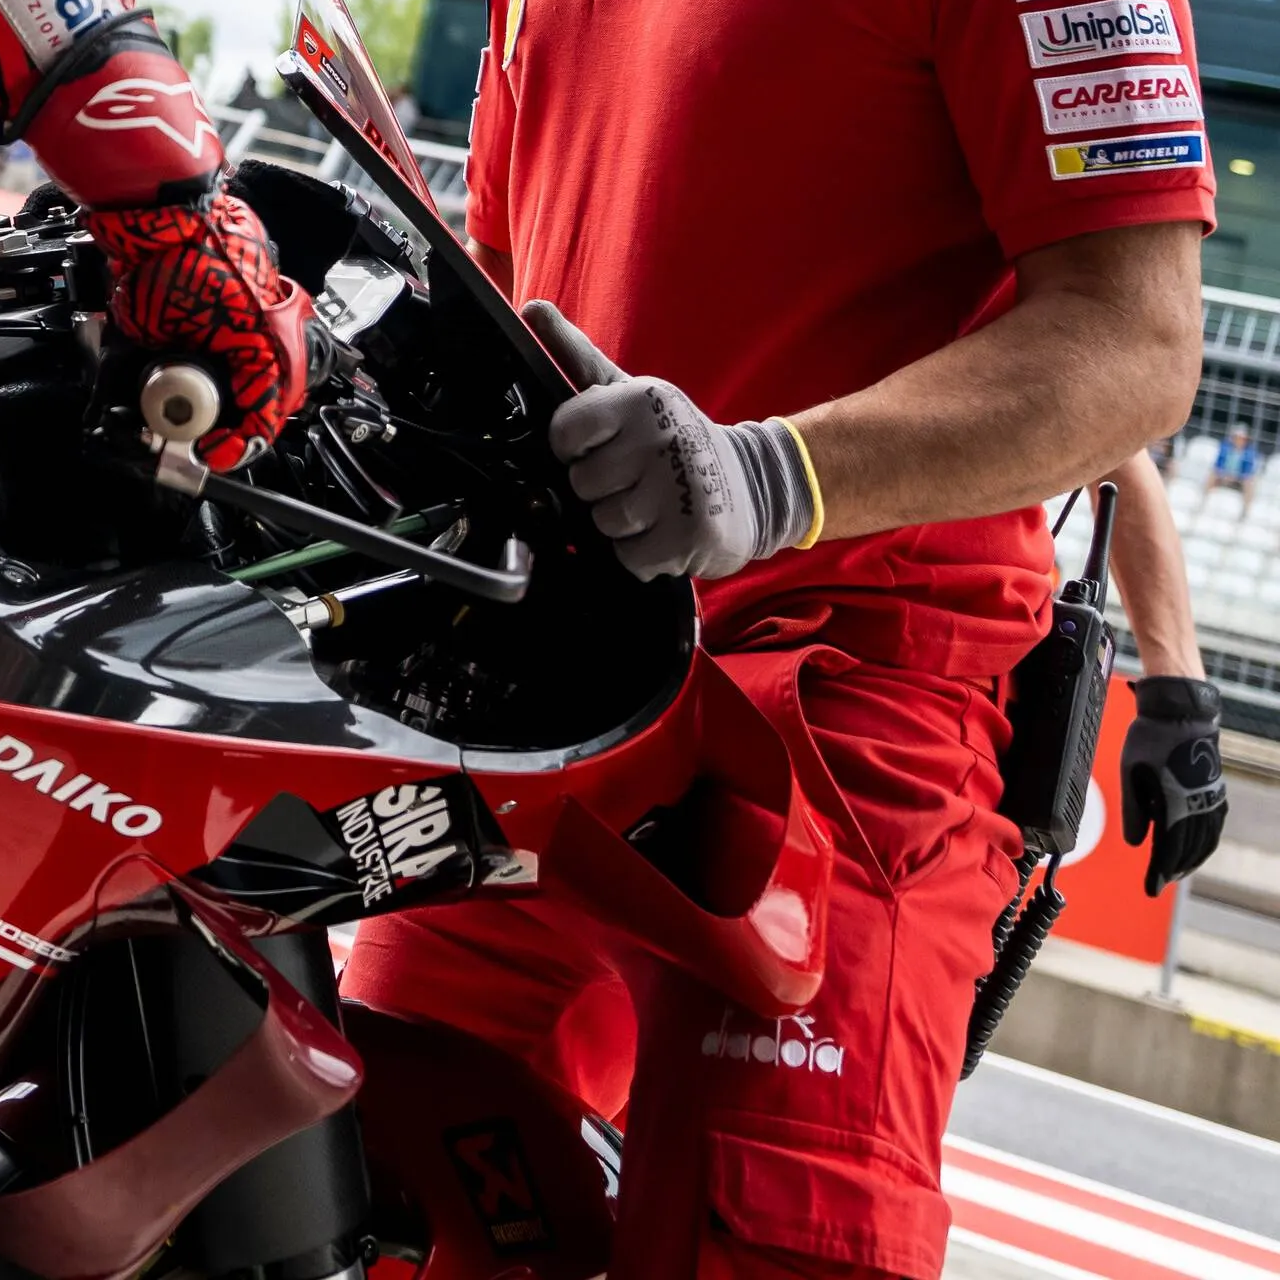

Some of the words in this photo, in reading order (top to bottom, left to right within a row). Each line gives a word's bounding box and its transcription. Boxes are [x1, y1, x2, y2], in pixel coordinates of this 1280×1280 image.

[1042, 3, 1171, 50] UnipolSai
[1051, 78, 1190, 110] CARRERA
[1113, 145, 1190, 162] MICHELIN
[666, 434, 693, 516] MAPA
[372, 783, 459, 880] SIRA
